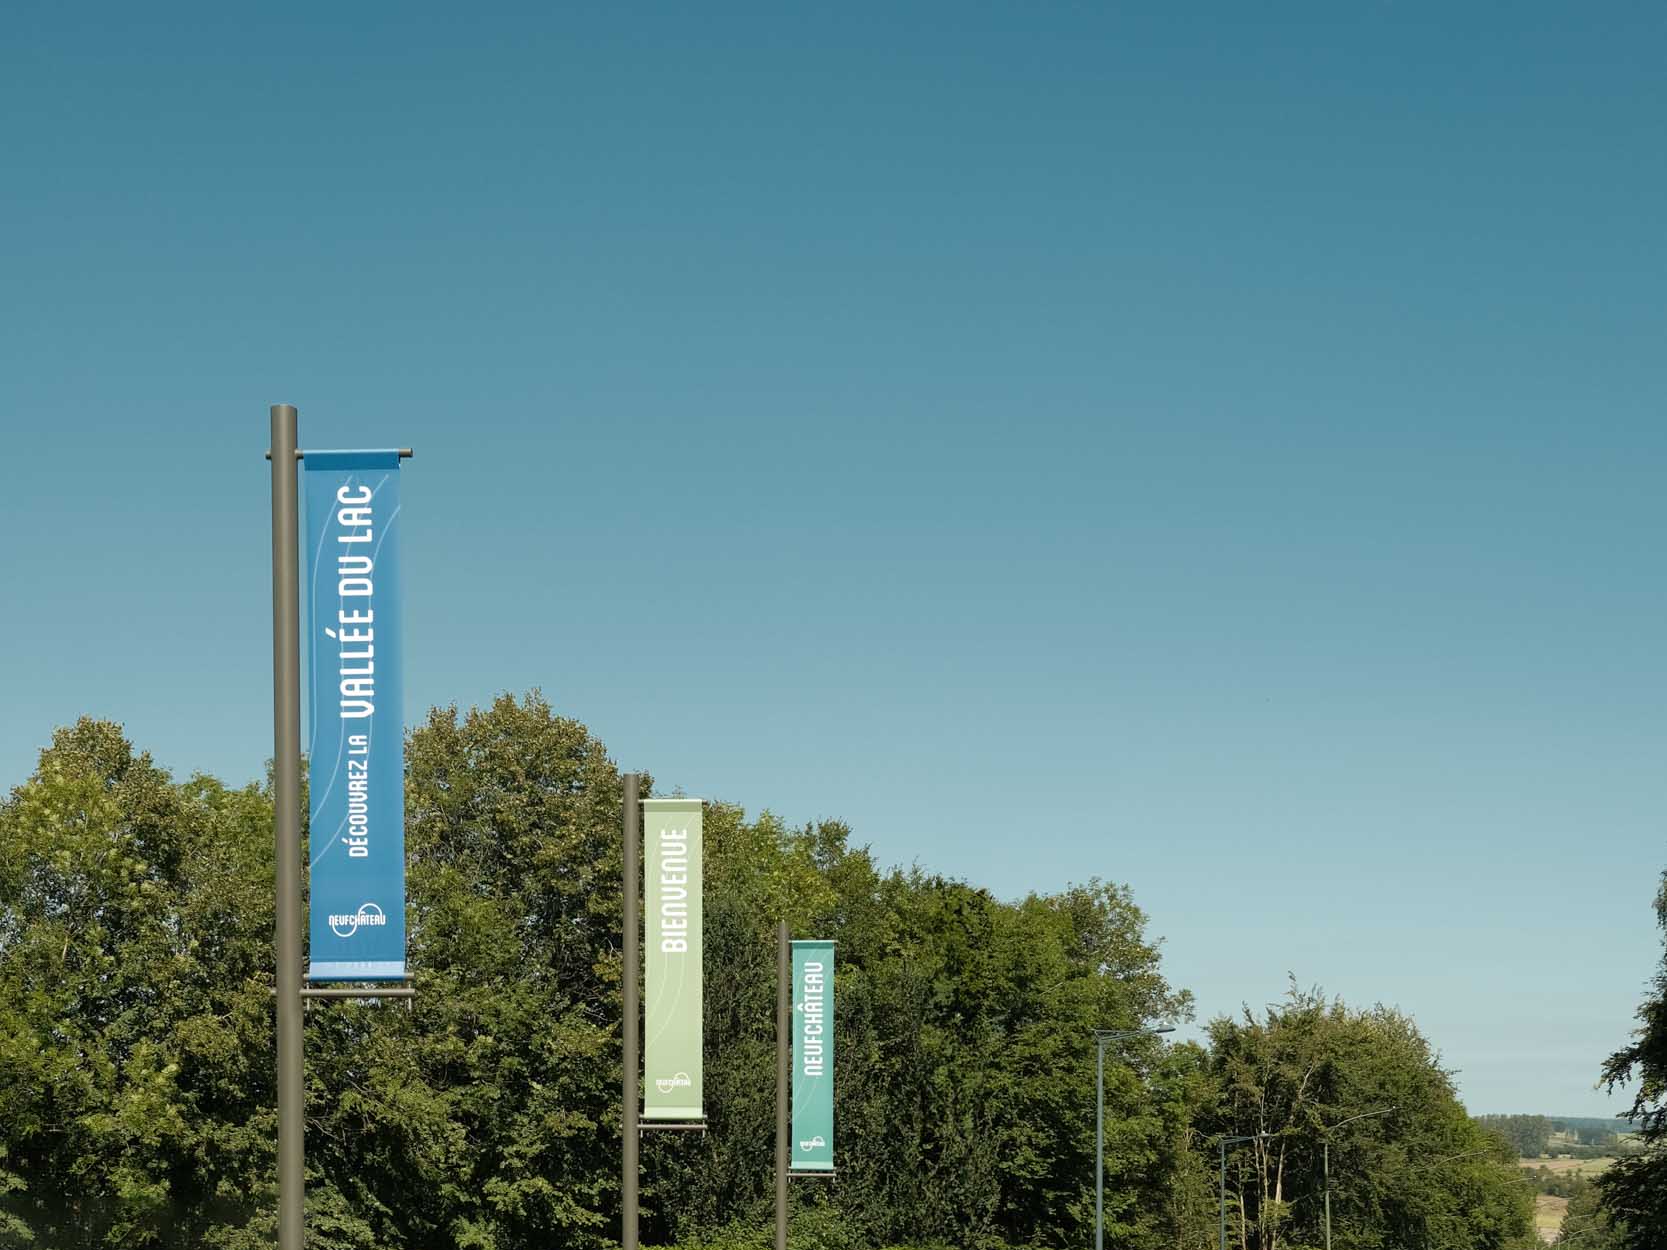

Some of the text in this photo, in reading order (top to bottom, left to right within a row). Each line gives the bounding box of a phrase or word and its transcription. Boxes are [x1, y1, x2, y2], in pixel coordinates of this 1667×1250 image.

[325, 485, 375, 858] DÉCOUVREZ LA VALLÉE DU LAC
[661, 828, 688, 953] BIENVENUE
[797, 962, 824, 1076] NEUFCHÂTEAU
